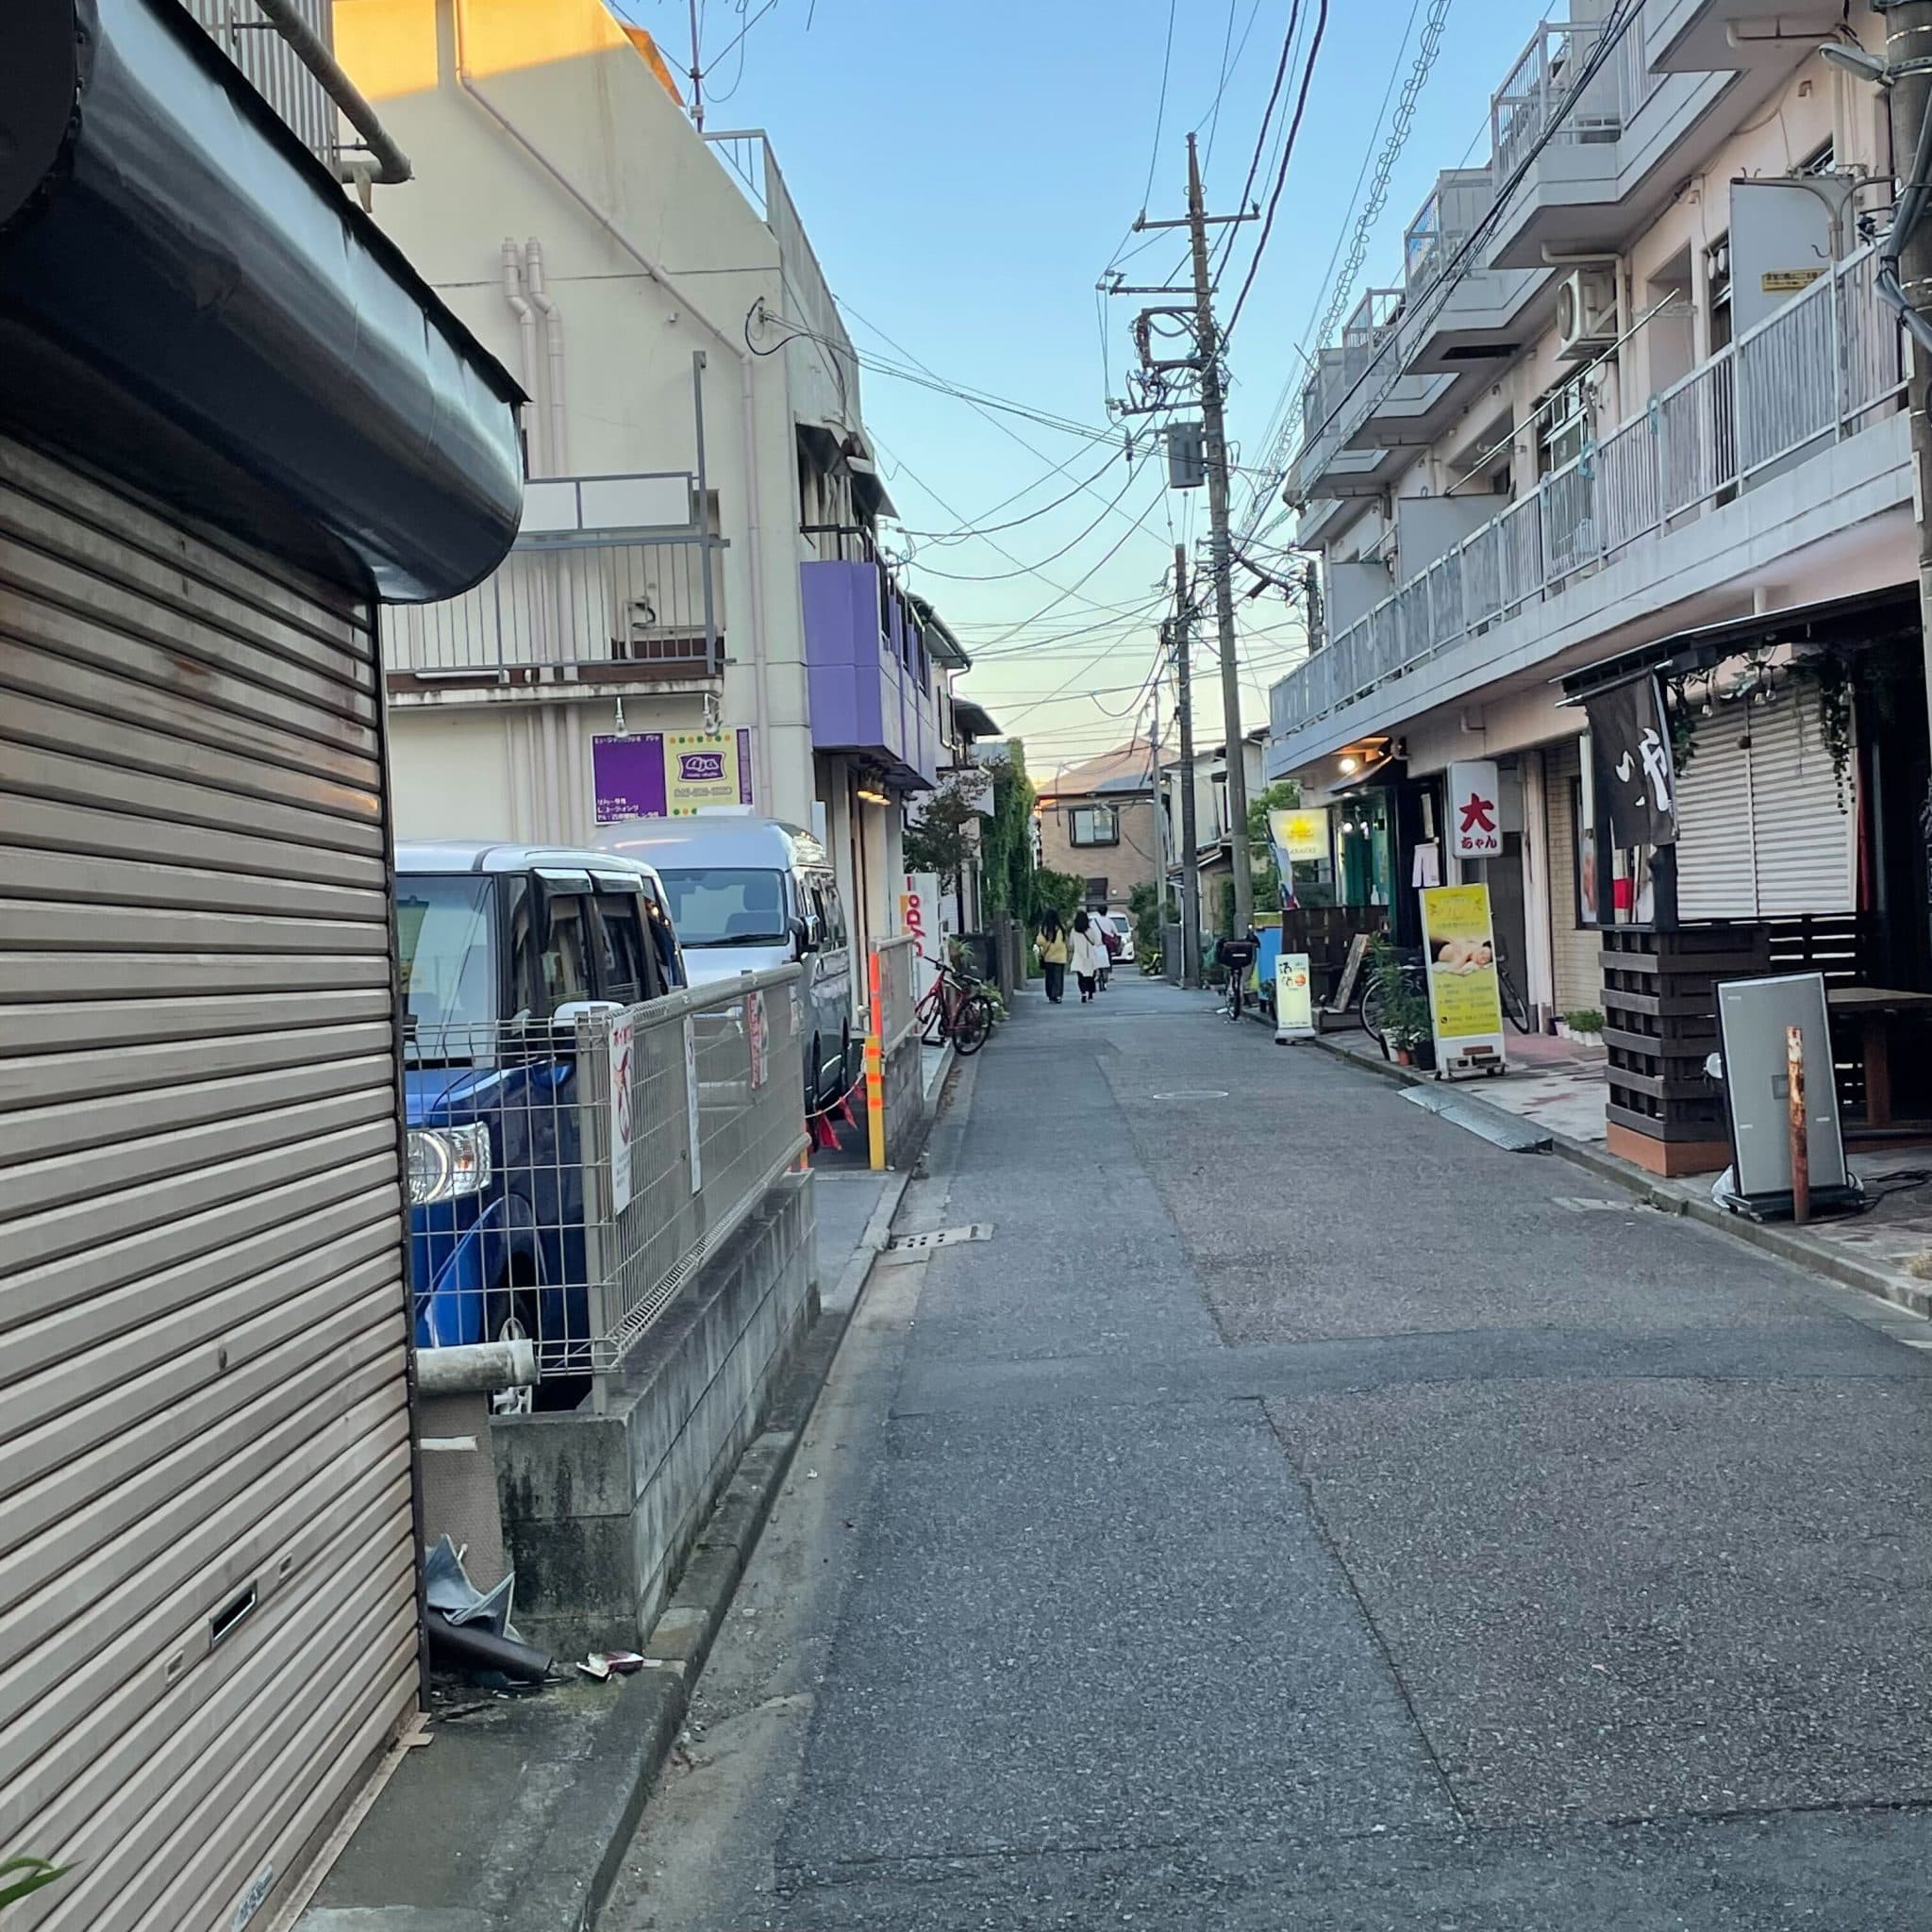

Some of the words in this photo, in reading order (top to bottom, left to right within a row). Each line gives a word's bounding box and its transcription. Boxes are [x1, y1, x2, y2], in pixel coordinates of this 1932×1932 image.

[1459, 793, 1496, 833] 大
[1461, 835, 1498, 849] ちゃん
